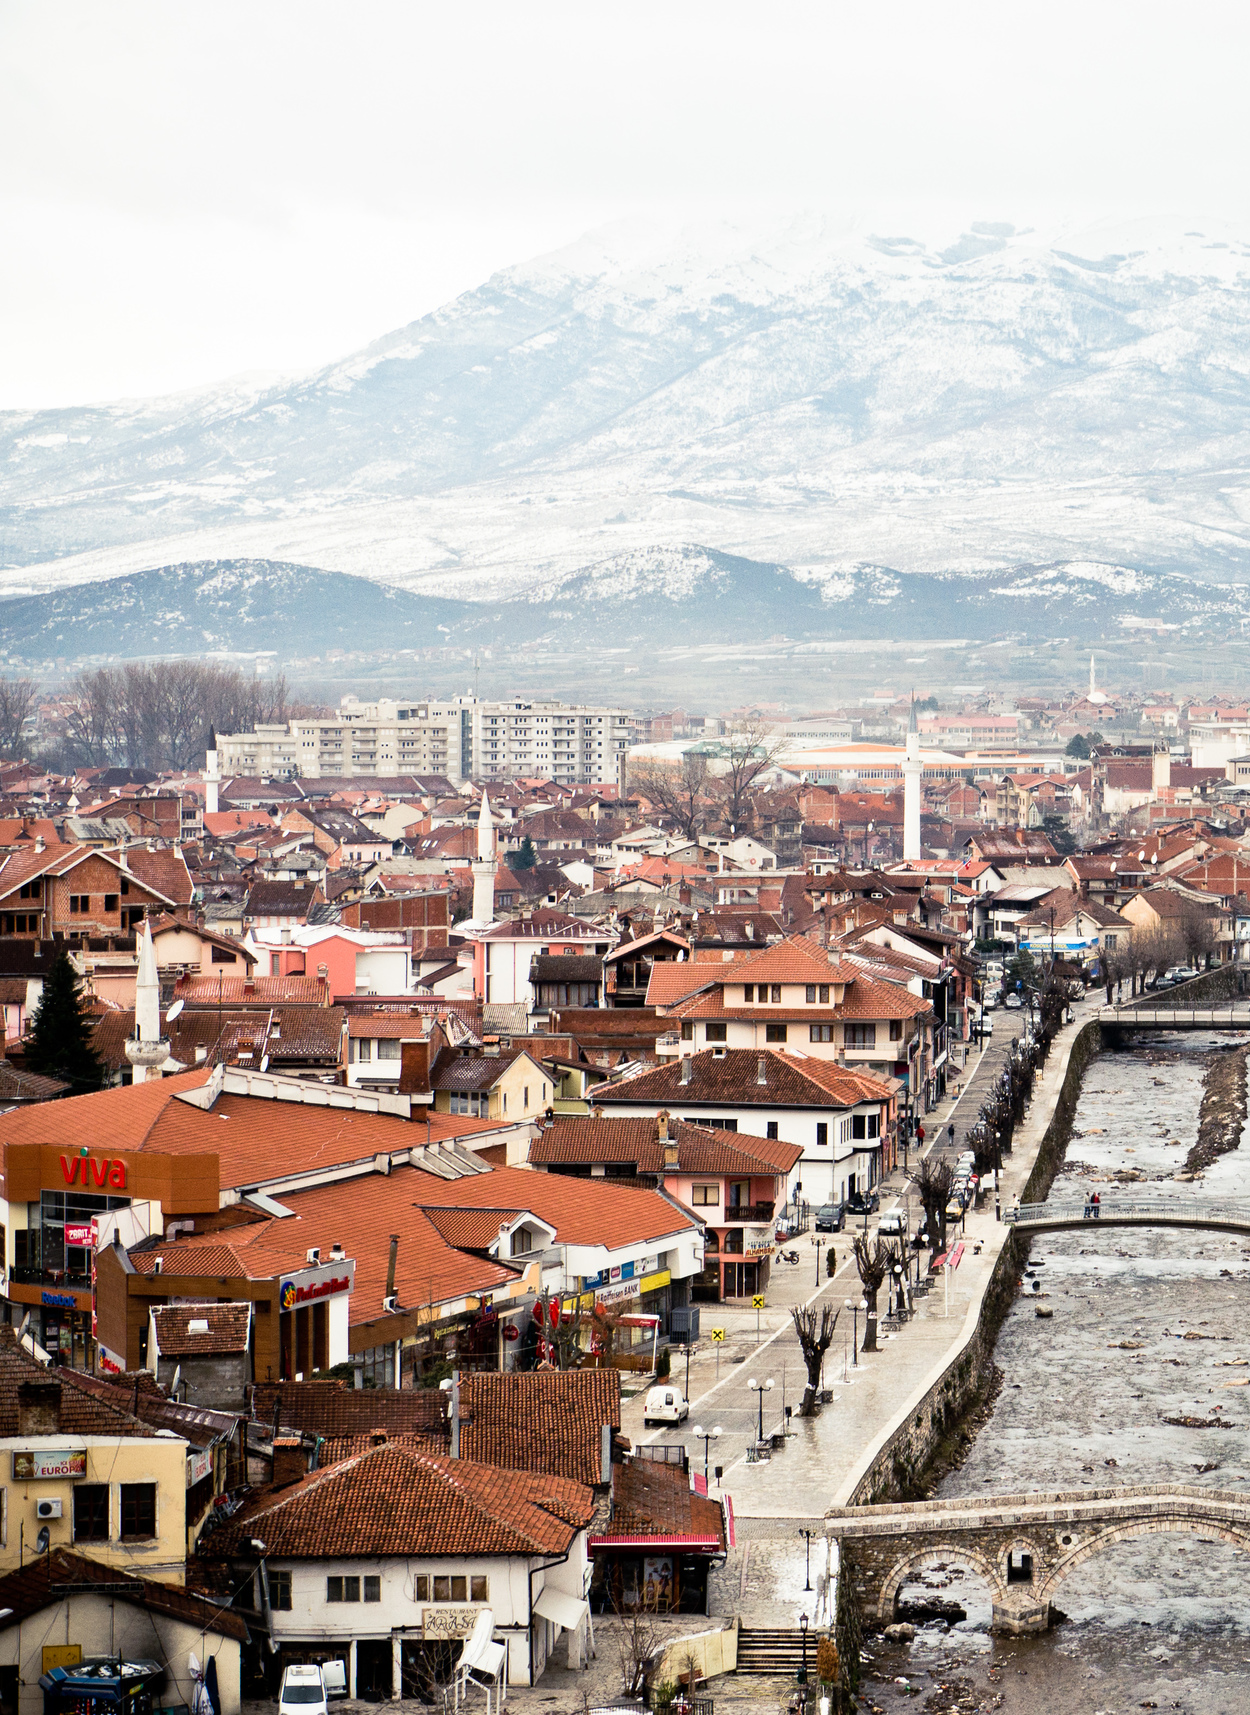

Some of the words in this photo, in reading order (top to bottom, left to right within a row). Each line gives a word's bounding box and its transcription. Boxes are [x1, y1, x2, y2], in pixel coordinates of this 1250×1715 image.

[60, 1147, 127, 1189] viva
[745, 1247, 775, 1256] ALHAMBRA
[624, 1283, 639, 1296] BANK
[41, 1291, 78, 1308] Reebok
[41, 1465, 81, 1476] EUROPA
